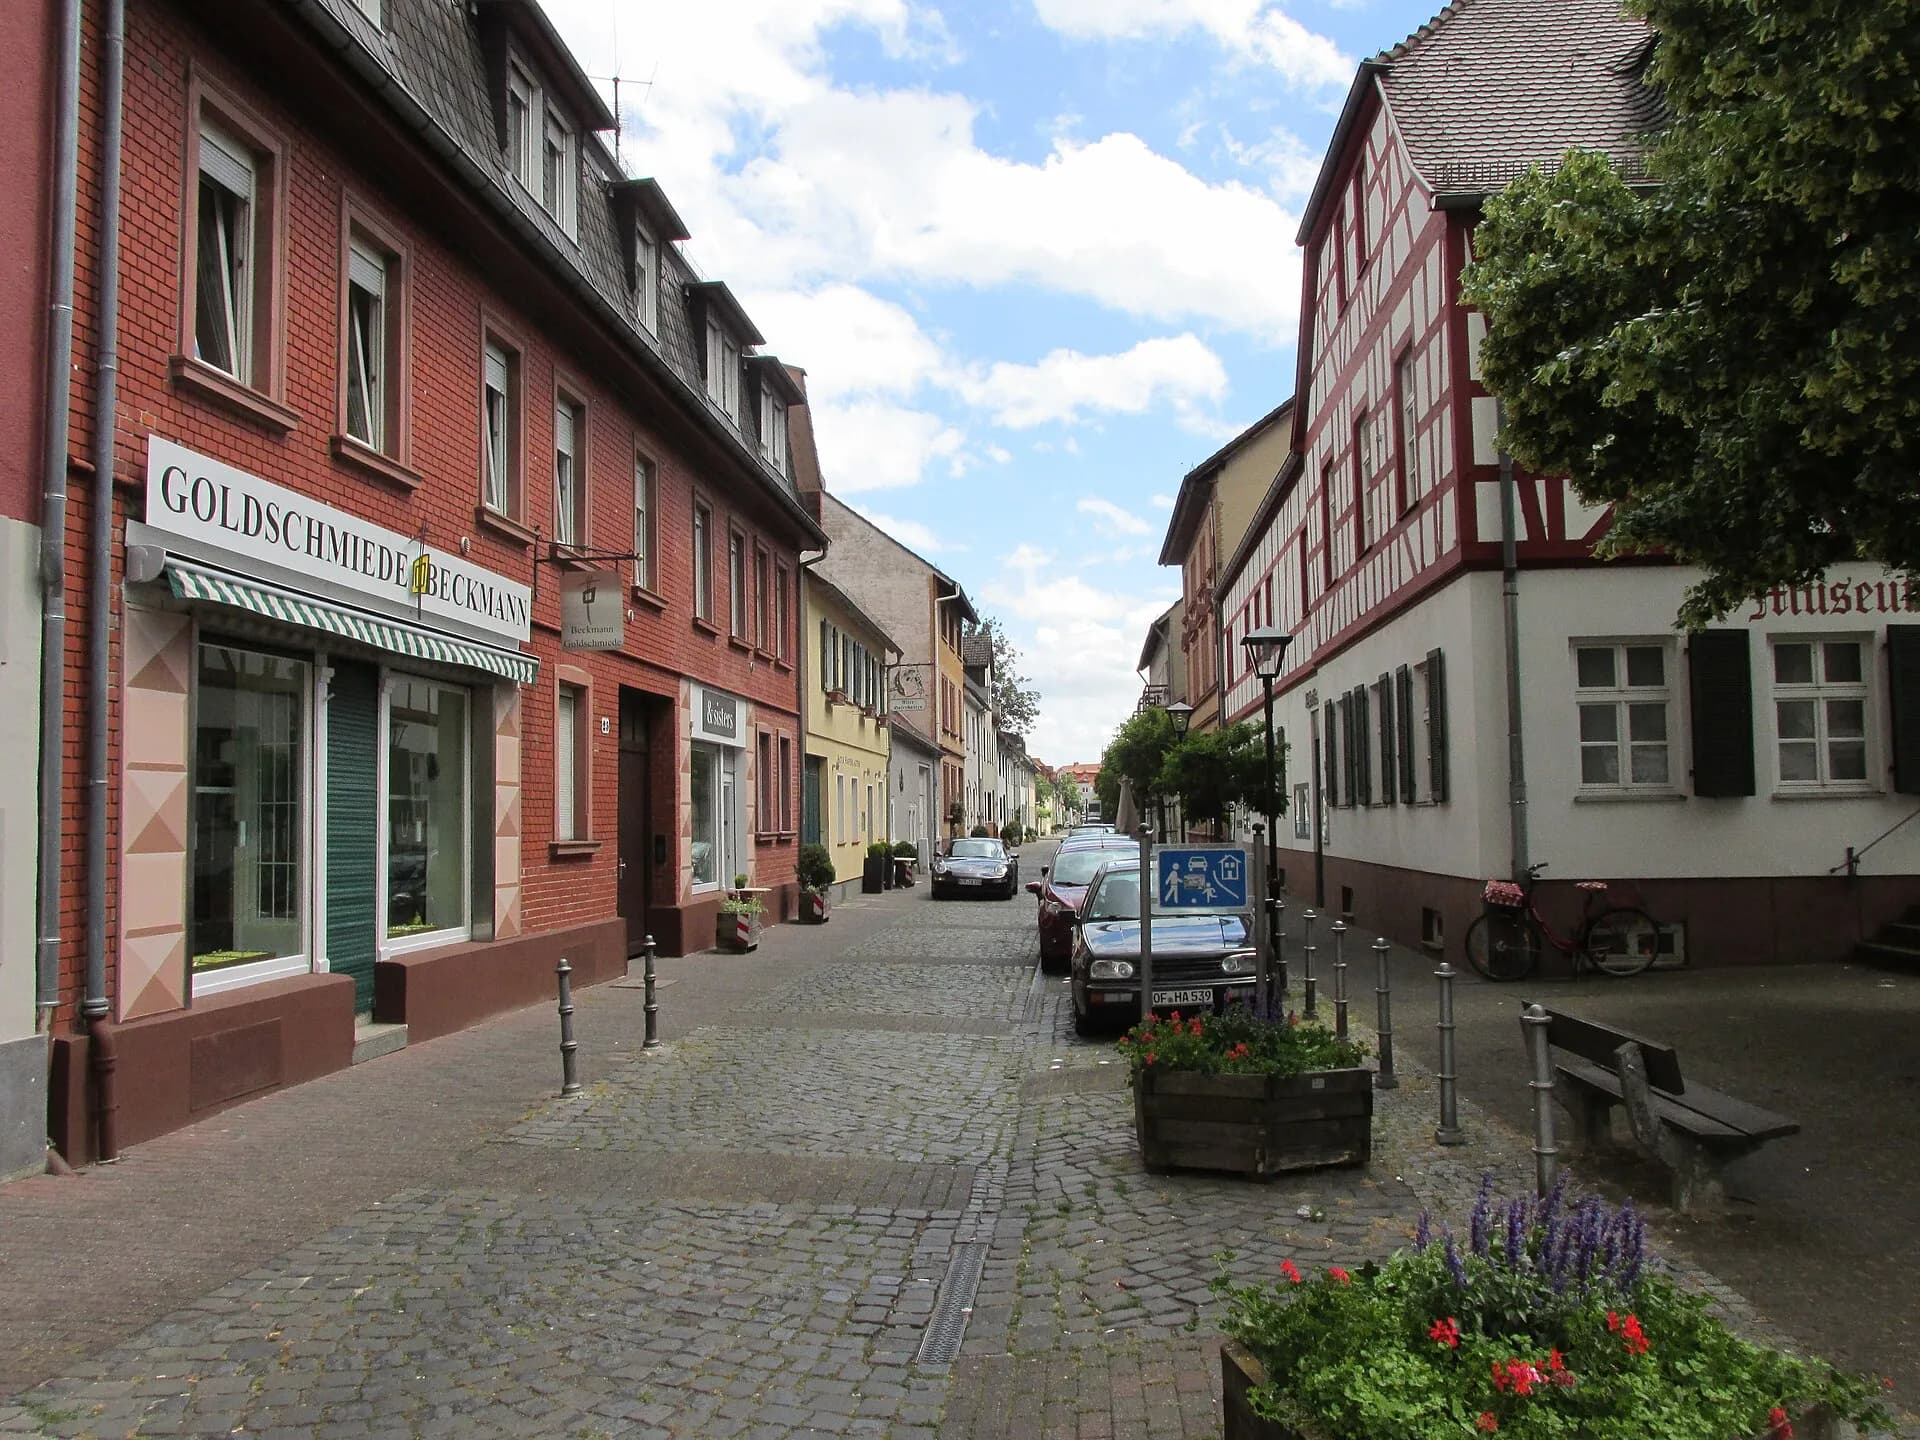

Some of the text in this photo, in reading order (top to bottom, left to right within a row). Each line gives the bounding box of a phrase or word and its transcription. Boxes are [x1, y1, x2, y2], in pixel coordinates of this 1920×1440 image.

[161, 464, 528, 628] GOLDSCHMIEDE BECKMANN
[571, 625, 614, 634] Beckmann
[563, 638, 623, 648] Goldschmiede
[1153, 990, 1212, 1003] OF HA 539
